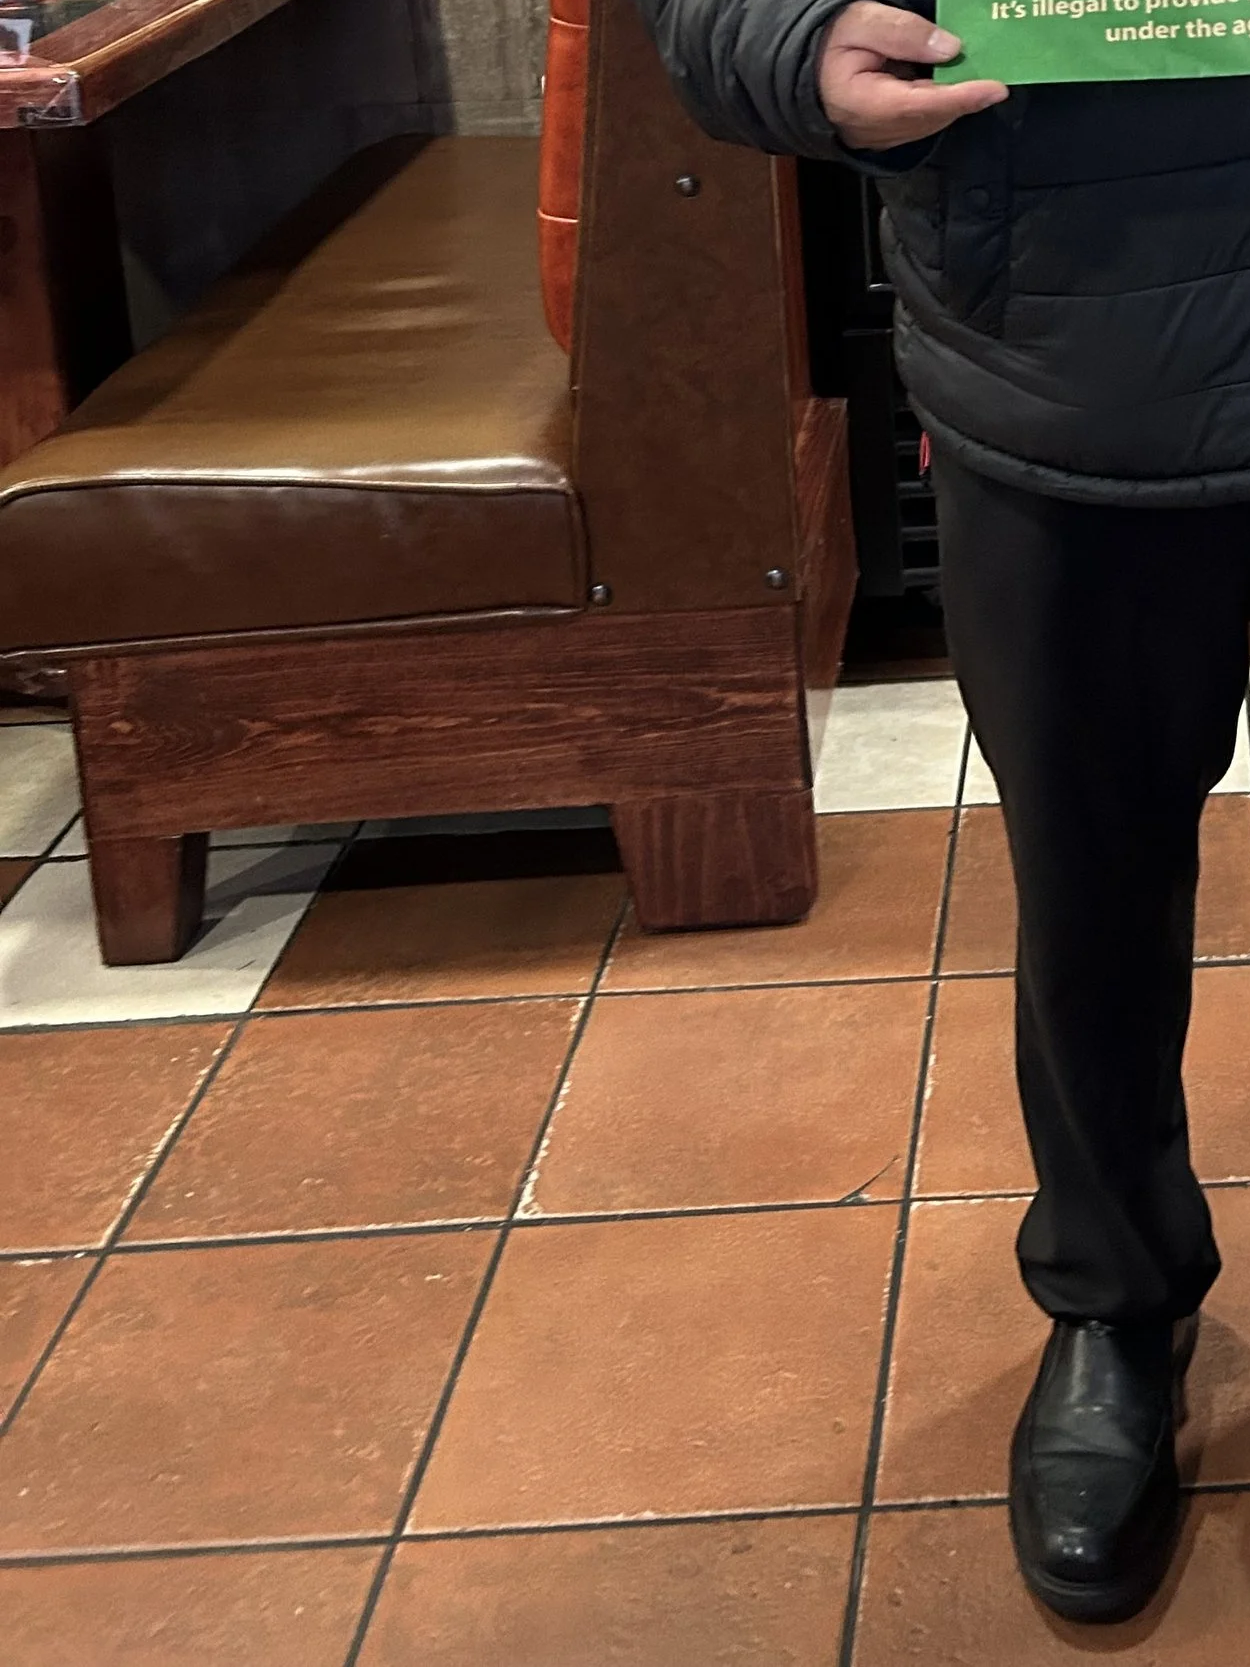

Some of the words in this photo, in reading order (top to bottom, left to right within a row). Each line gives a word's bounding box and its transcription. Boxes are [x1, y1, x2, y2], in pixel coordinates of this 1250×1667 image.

[991, 0, 1027, 20] It's
[1105, 21, 1181, 42] under
[1185, 18, 1227, 38] the
